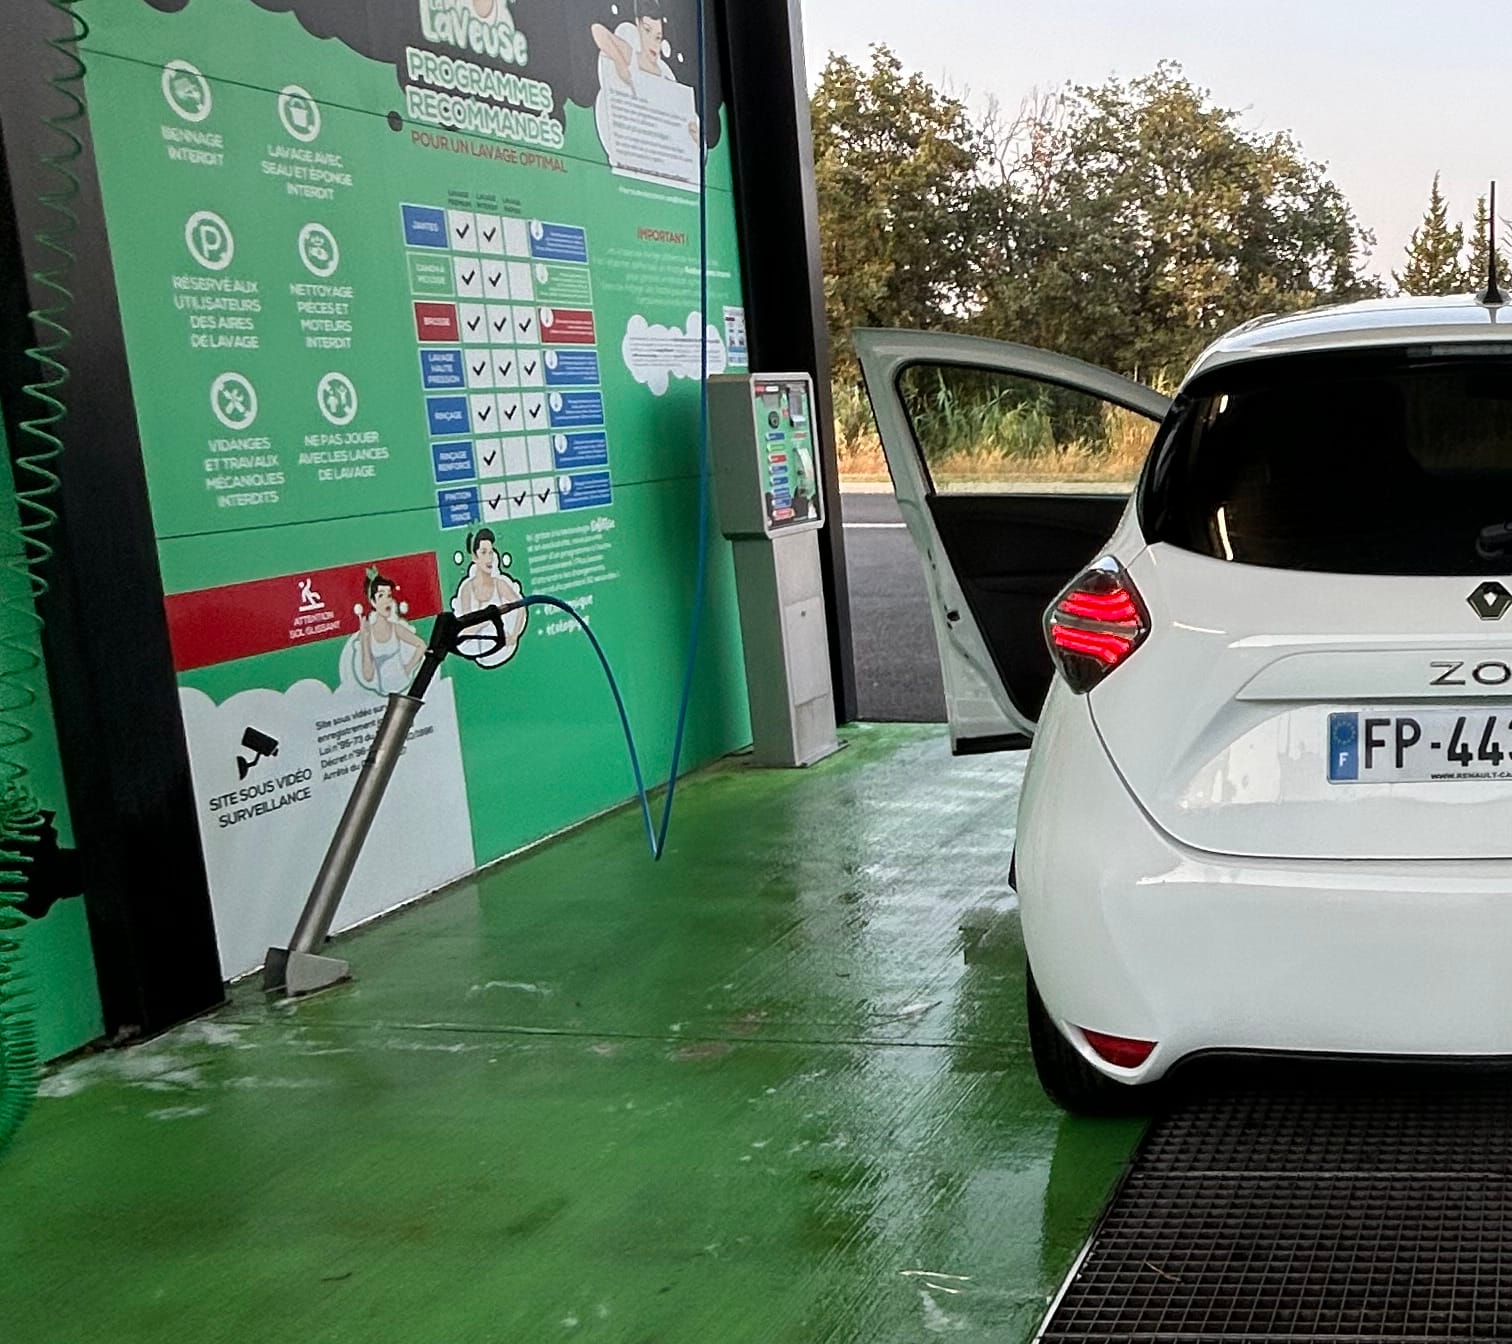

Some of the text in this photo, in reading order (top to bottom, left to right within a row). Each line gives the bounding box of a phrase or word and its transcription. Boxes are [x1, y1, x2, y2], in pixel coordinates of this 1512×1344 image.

[407, 48, 553, 111] PROGRAMMES
[407, 86, 564, 148] RECOMMANDÉS
[167, 145, 224, 167] INTERDIT
[267, 145, 343, 168] LAVAGE AVEC
[411, 130, 568, 174] POUR UN LAVAGE OPTIMAL
[261, 161, 353, 186] SEAU ET ÉPONGE
[286, 183, 335, 201] INTERDIT
[173, 274, 259, 294] RÉSERVÉ AUX
[290, 283, 354, 299] NETTOYAGE
[174, 295, 262, 313] UTILISATEURS
[335, 303, 348, 315] ET
[190, 315, 254, 330] DES AIRES
[301, 319, 352, 333] MOTEURS
[191, 334, 260, 349] DE LAVAGE
[305, 336, 351, 349] INTERDIT
[208, 436, 271, 453] VIDANGES
[304, 431, 379, 447] NE PAS JOUER
[204, 455, 279, 472] ET TRAVAUX
[298, 447, 390, 465] AVEC LES LANCES
[205, 472, 286, 490] MÉCANIQUES
[318, 465, 376, 481] DE LAVAGE
[217, 491, 280, 507] INTERDITS
[293, 611, 335, 626] ATTENTION
[289, 629, 304, 640] SOL
[1339, 752, 1349, 768] F
[208, 767, 313, 813] SITE SOUS VIDÉO
[218, 786, 313, 829] SURVEILLANCE
